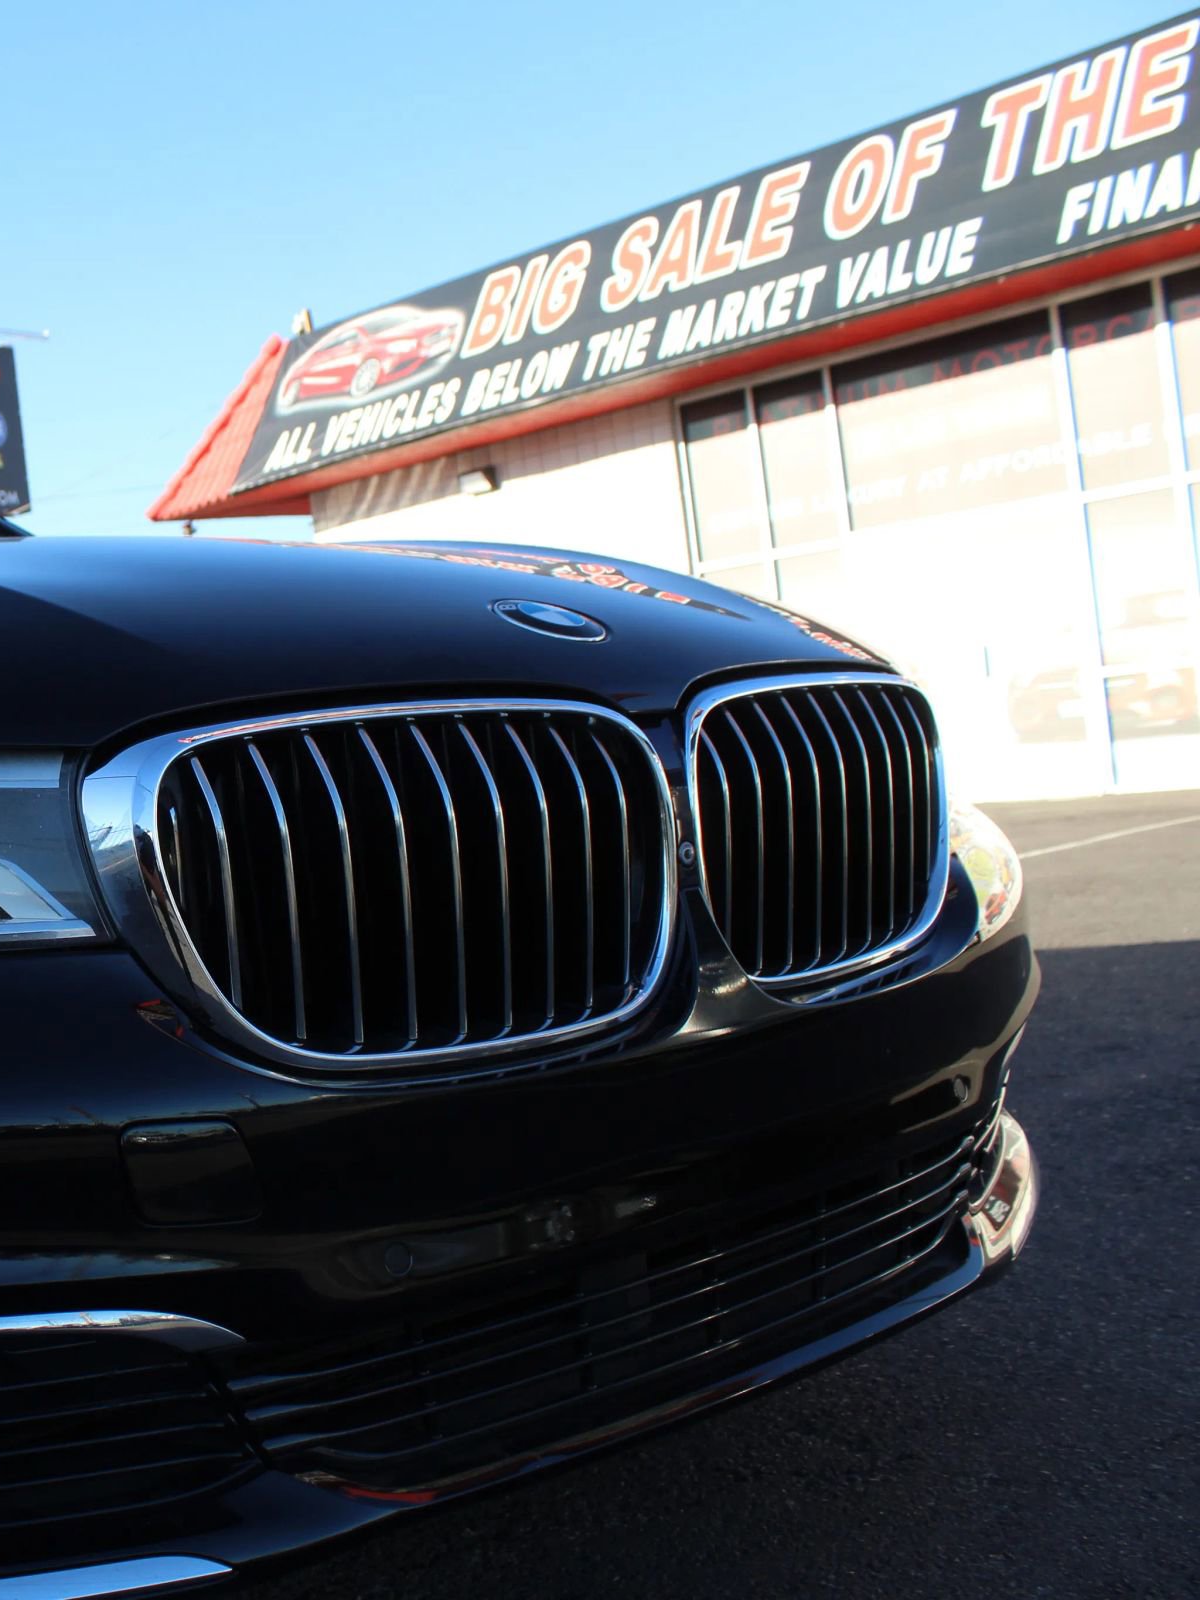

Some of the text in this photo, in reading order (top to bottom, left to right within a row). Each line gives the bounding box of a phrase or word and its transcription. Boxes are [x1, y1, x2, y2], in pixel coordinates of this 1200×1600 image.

[459, 18, 1200, 359] BIG SALE OF THE
[263, 422, 317, 473] ALL
[321, 377, 462, 457] VEHICLES
[460, 340, 580, 417] BELOW
[582, 316, 656, 382] THE
[657, 265, 827, 360] MARKET
[836, 216, 983, 309] VALUE
